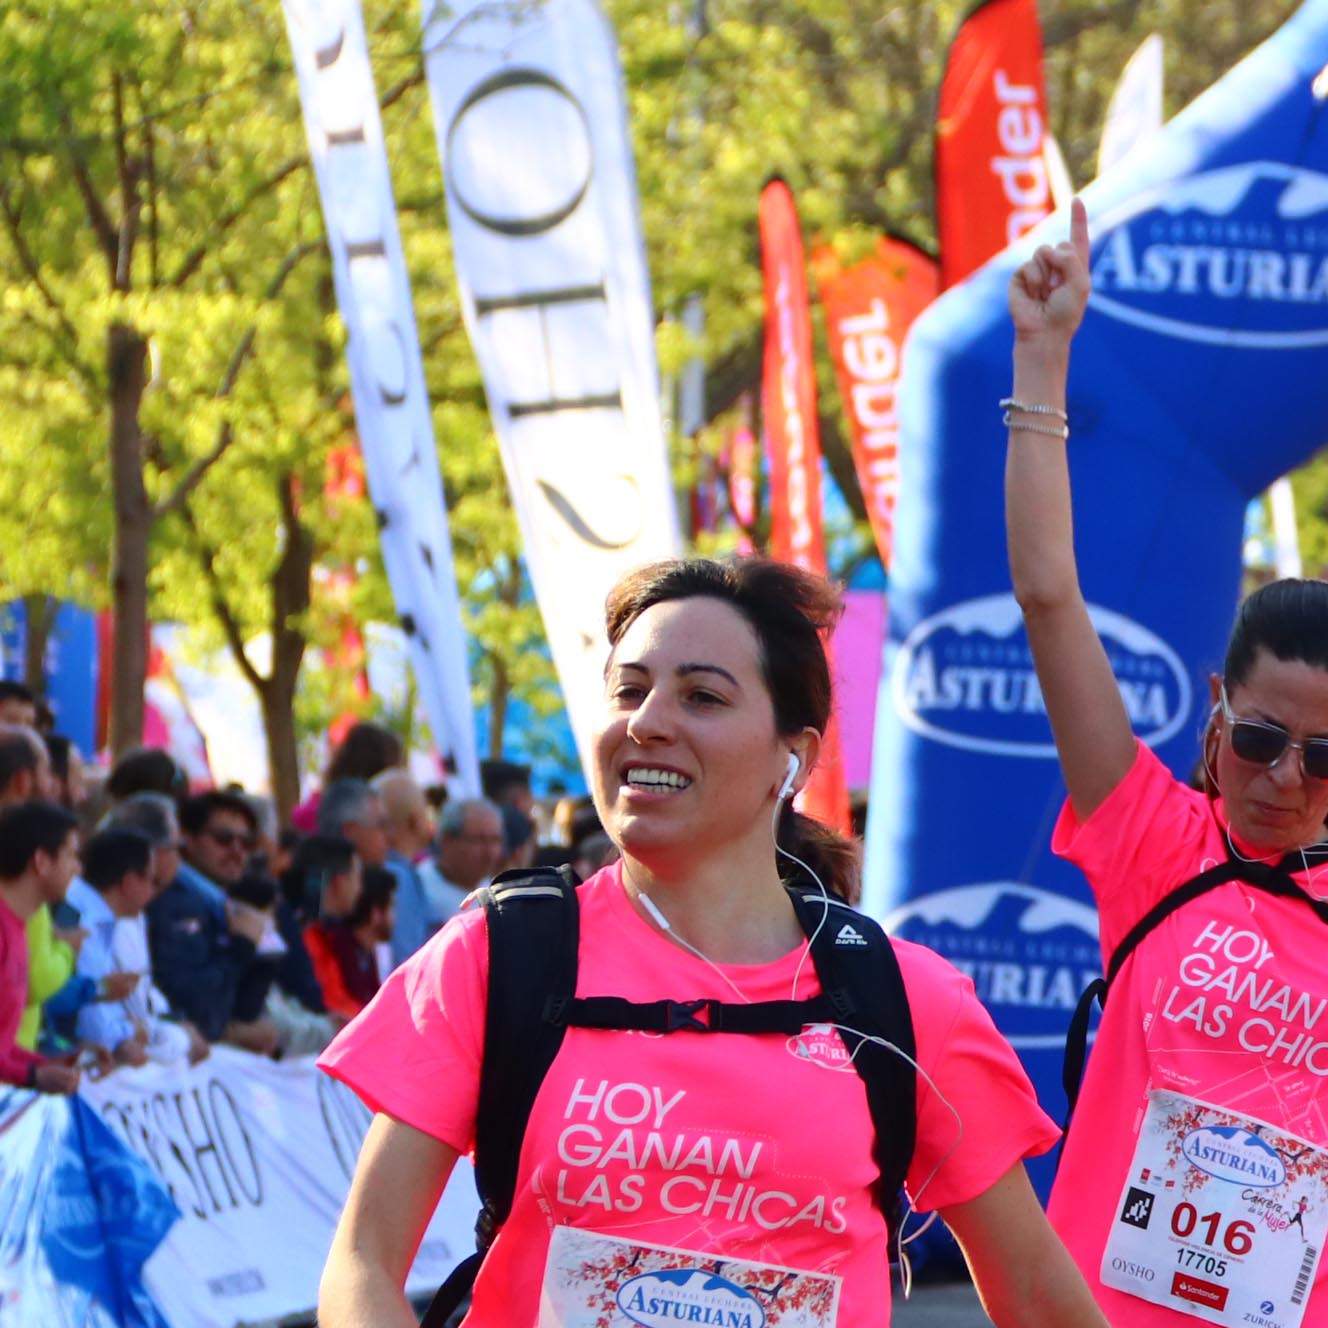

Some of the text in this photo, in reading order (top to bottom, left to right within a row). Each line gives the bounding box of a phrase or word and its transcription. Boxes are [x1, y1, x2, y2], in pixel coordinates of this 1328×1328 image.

[1193, 920, 1275, 970] HOY
[1162, 986, 1233, 1038] LAS
[1179, 952, 1328, 1030] GANAN
[564, 1078, 687, 1129] HOY
[557, 1124, 763, 1179] GANAN
[1187, 1136, 1276, 1183] ASTURIANA
[557, 1169, 847, 1234] LAS CHICAS
[1242, 1189, 1282, 1212] Carrera
[1171, 1202, 1256, 1255] 016
[1112, 1257, 1155, 1282] OYSHO
[1177, 1248, 1228, 1277] 17705
[1187, 1284, 1220, 1301] Santander
